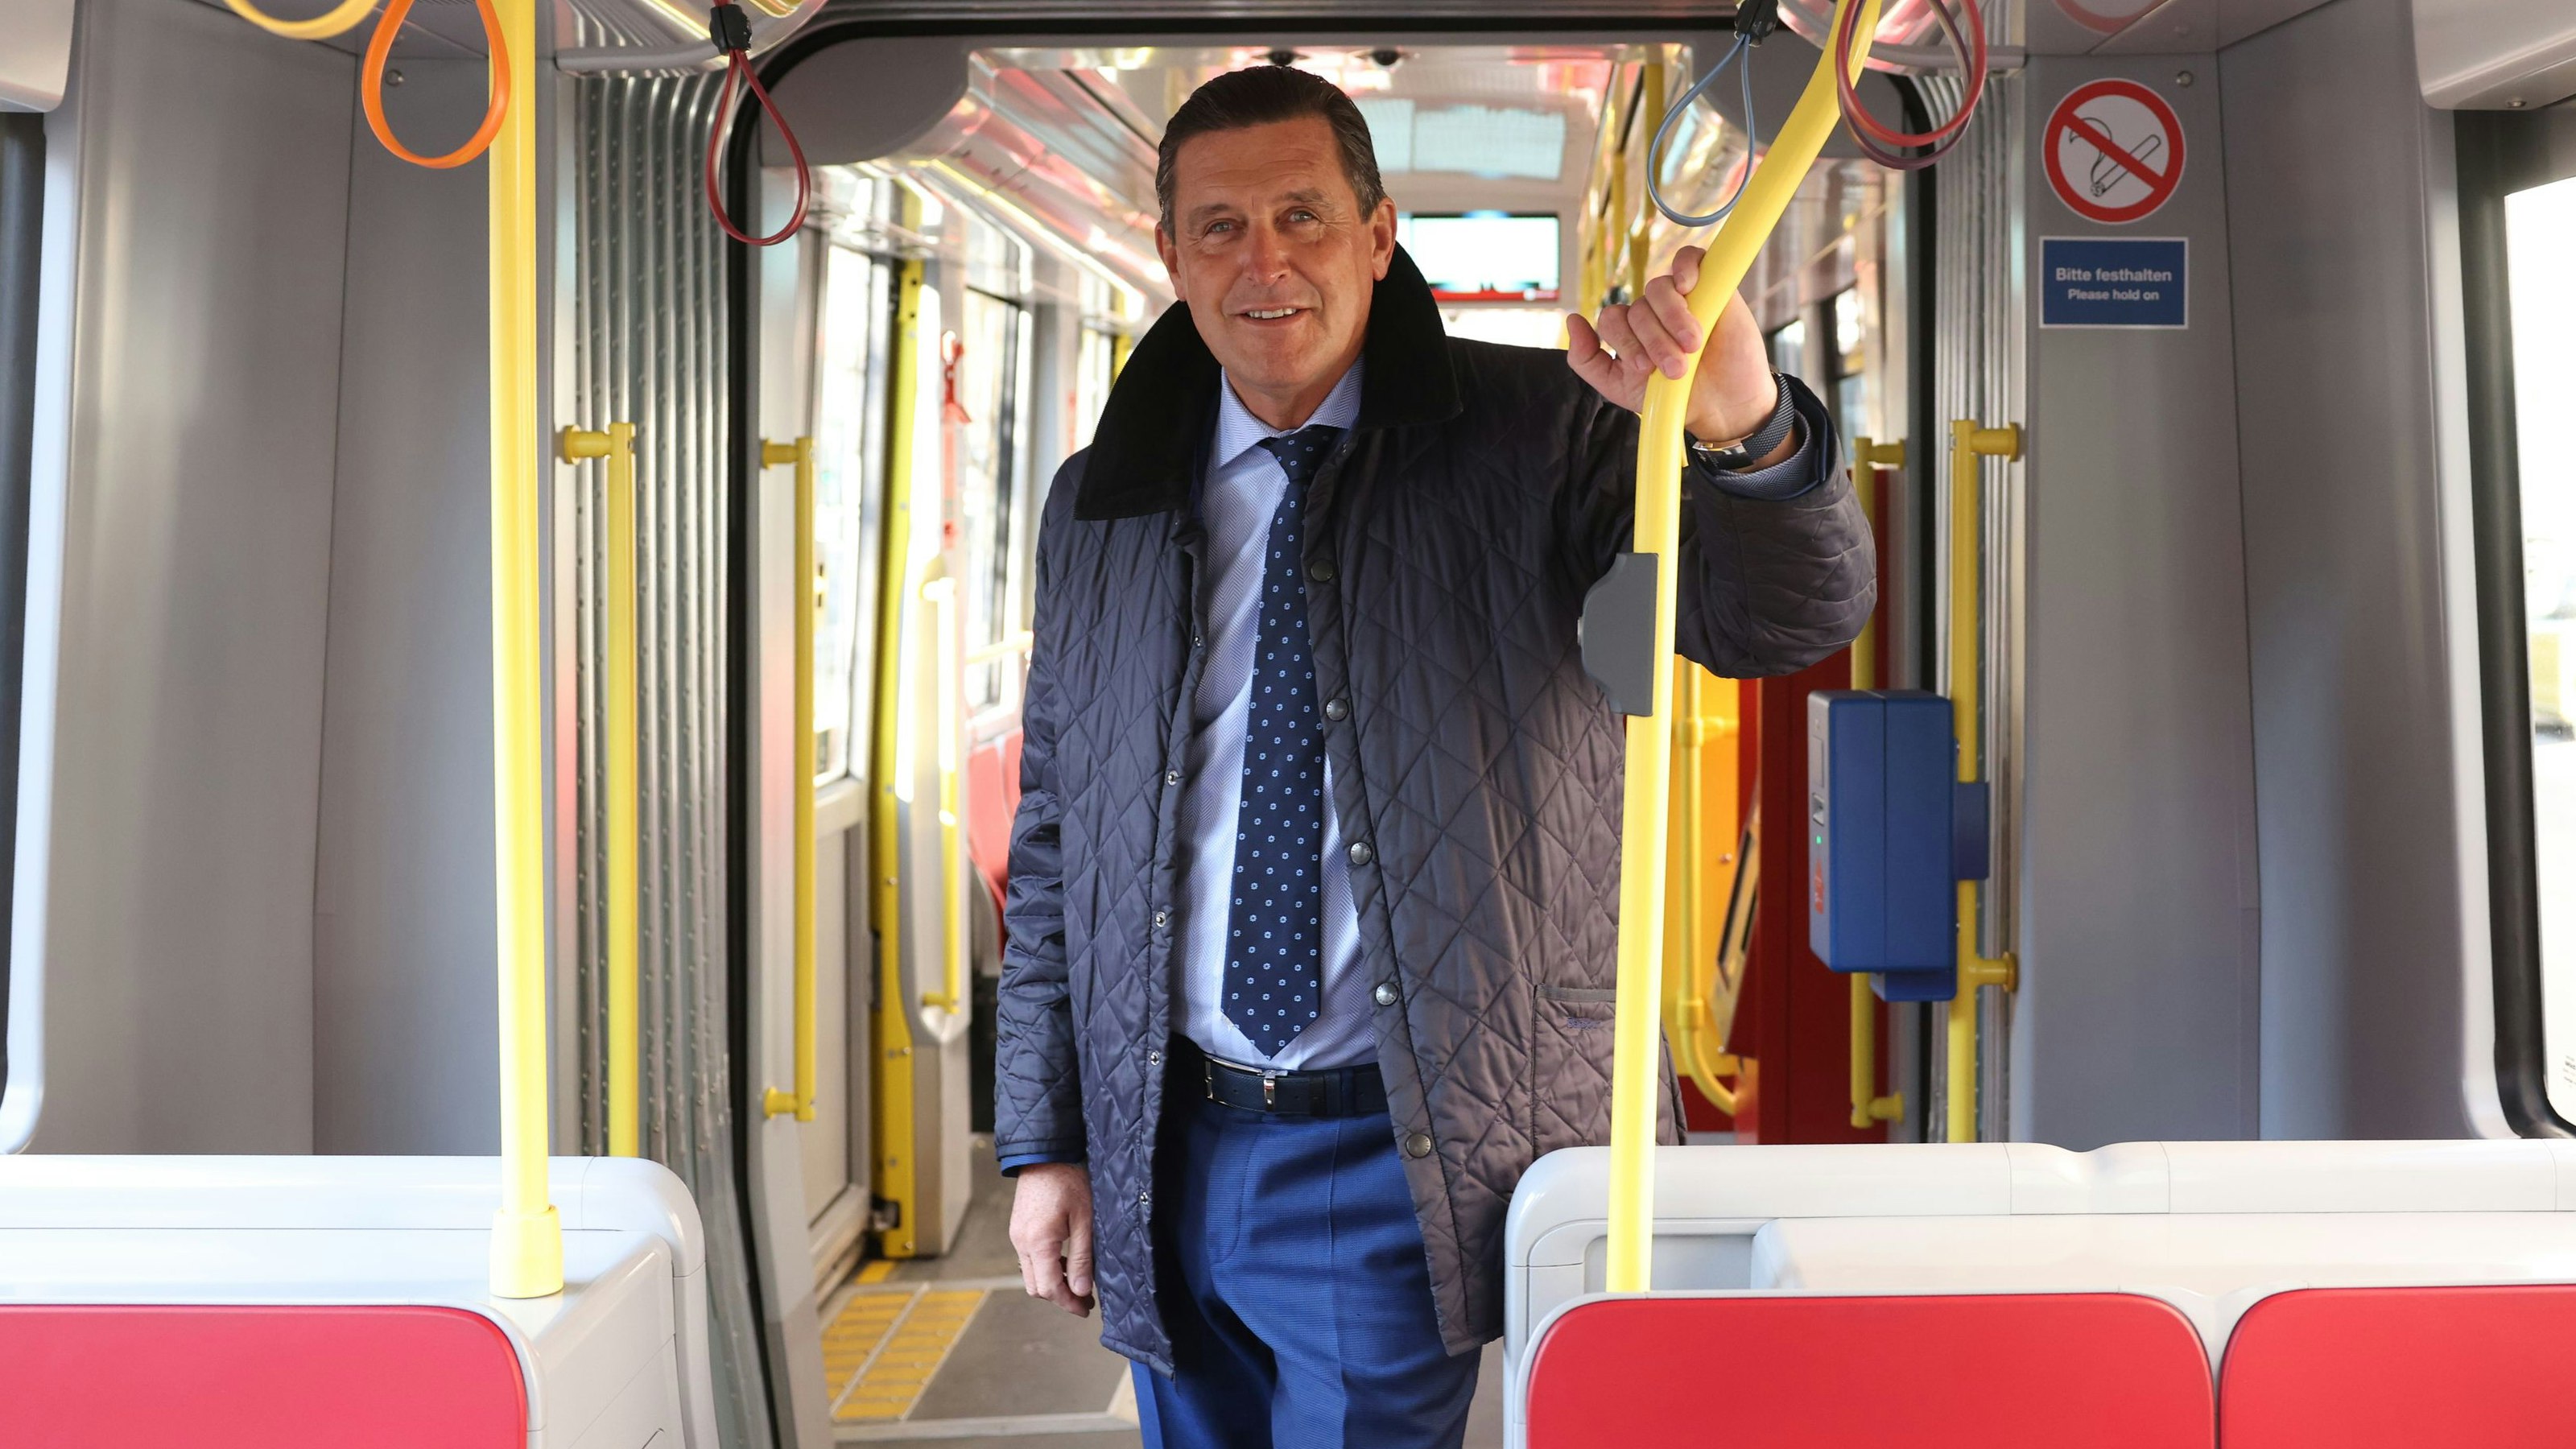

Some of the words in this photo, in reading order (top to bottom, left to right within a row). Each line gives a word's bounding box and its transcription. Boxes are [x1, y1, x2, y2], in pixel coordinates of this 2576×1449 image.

[2055, 267, 2092, 282] Bitte
[2095, 268, 2173, 282] festhalten
[2067, 289, 2110, 301] Please
[2112, 289, 2140, 301] hold
[2142, 291, 2160, 301] on
